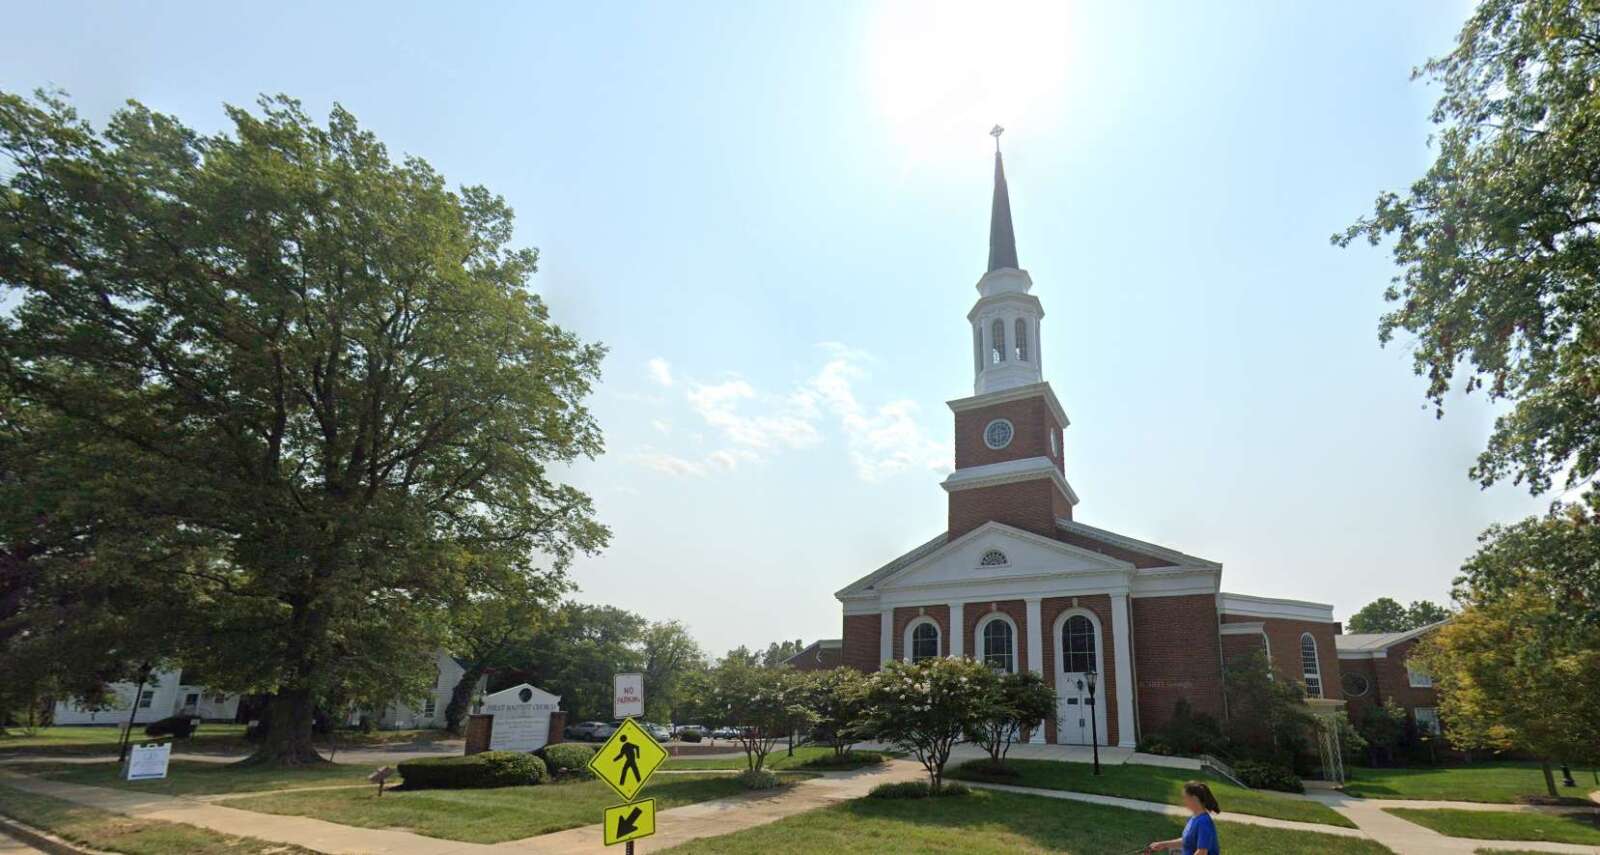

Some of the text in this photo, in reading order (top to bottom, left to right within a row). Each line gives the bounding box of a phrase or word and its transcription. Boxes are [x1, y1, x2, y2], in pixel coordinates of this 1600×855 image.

[624, 687, 634, 695] NO
[616, 696, 641, 704] PARKING
[533, 703, 557, 711] CHURCH
